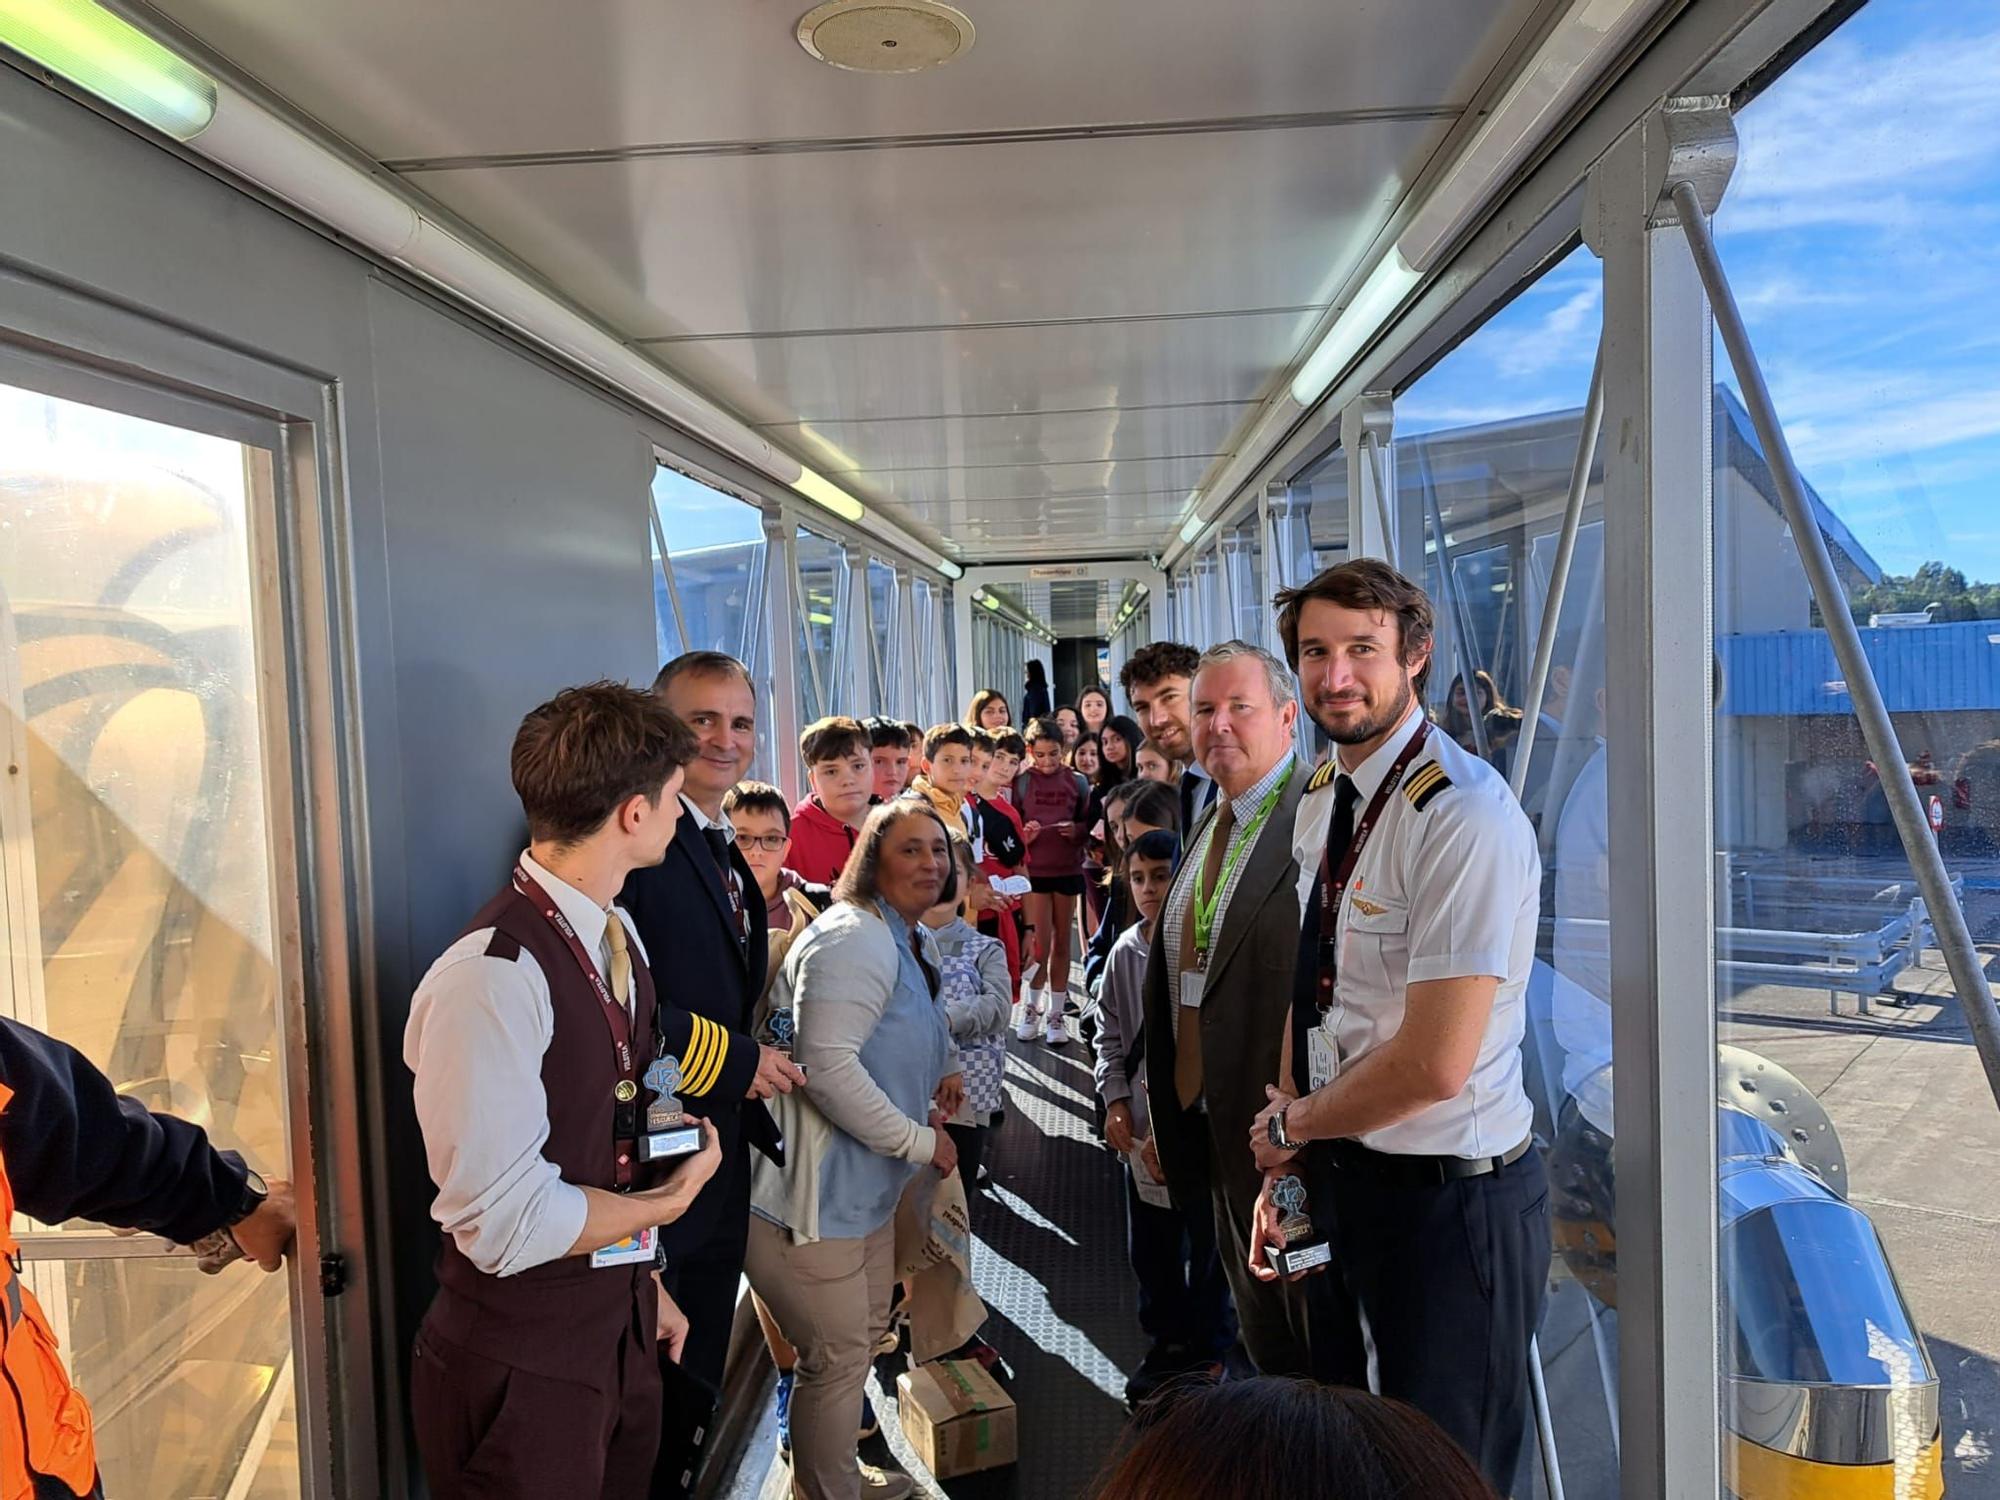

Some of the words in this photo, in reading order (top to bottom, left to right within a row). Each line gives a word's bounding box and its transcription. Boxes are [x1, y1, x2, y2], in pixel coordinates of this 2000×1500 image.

[1386, 771, 1402, 794] VOLOTEA
[1355, 829, 1369, 854] VOLOTEA
[554, 912, 575, 938] VOLOTEA
[595, 976, 612, 1005] VOLOTEA
[621, 1045, 632, 1072] VOLOTEA
